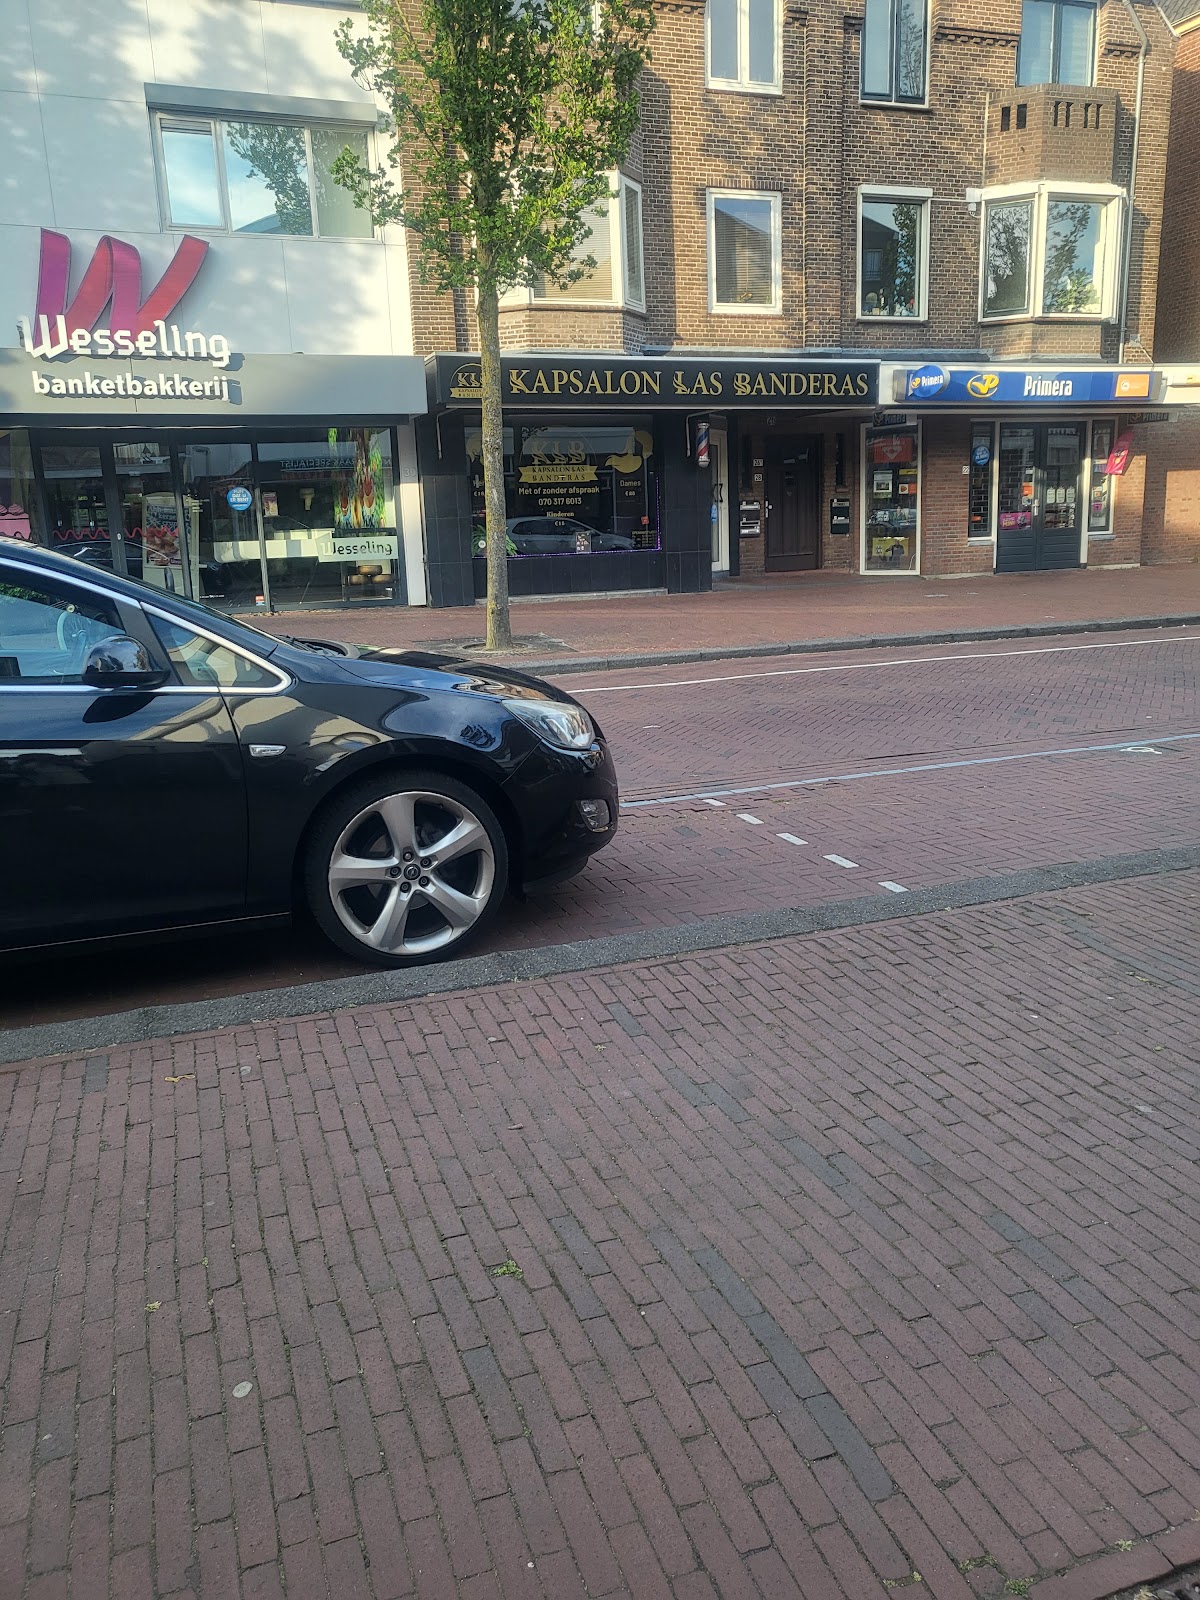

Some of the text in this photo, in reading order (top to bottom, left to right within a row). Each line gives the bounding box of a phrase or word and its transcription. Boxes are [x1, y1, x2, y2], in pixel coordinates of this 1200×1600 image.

[18, 314, 230, 367] Wesseling
[32, 371, 229, 401] banketbakkerij
[457, 372, 483, 387] KL
[509, 369, 868, 396] KAPSALON LAS BANDERAS
[921, 375, 944, 387] Primera
[1023, 375, 1073, 397] Primera
[532, 440, 586, 464] KLB
[403, 467, 416, 477] 30
[518, 486, 600, 496] Met of zonder afspraak
[538, 498, 552, 506] 070
[565, 497, 582, 505] 6013
[320, 541, 393, 556] Wesseling
